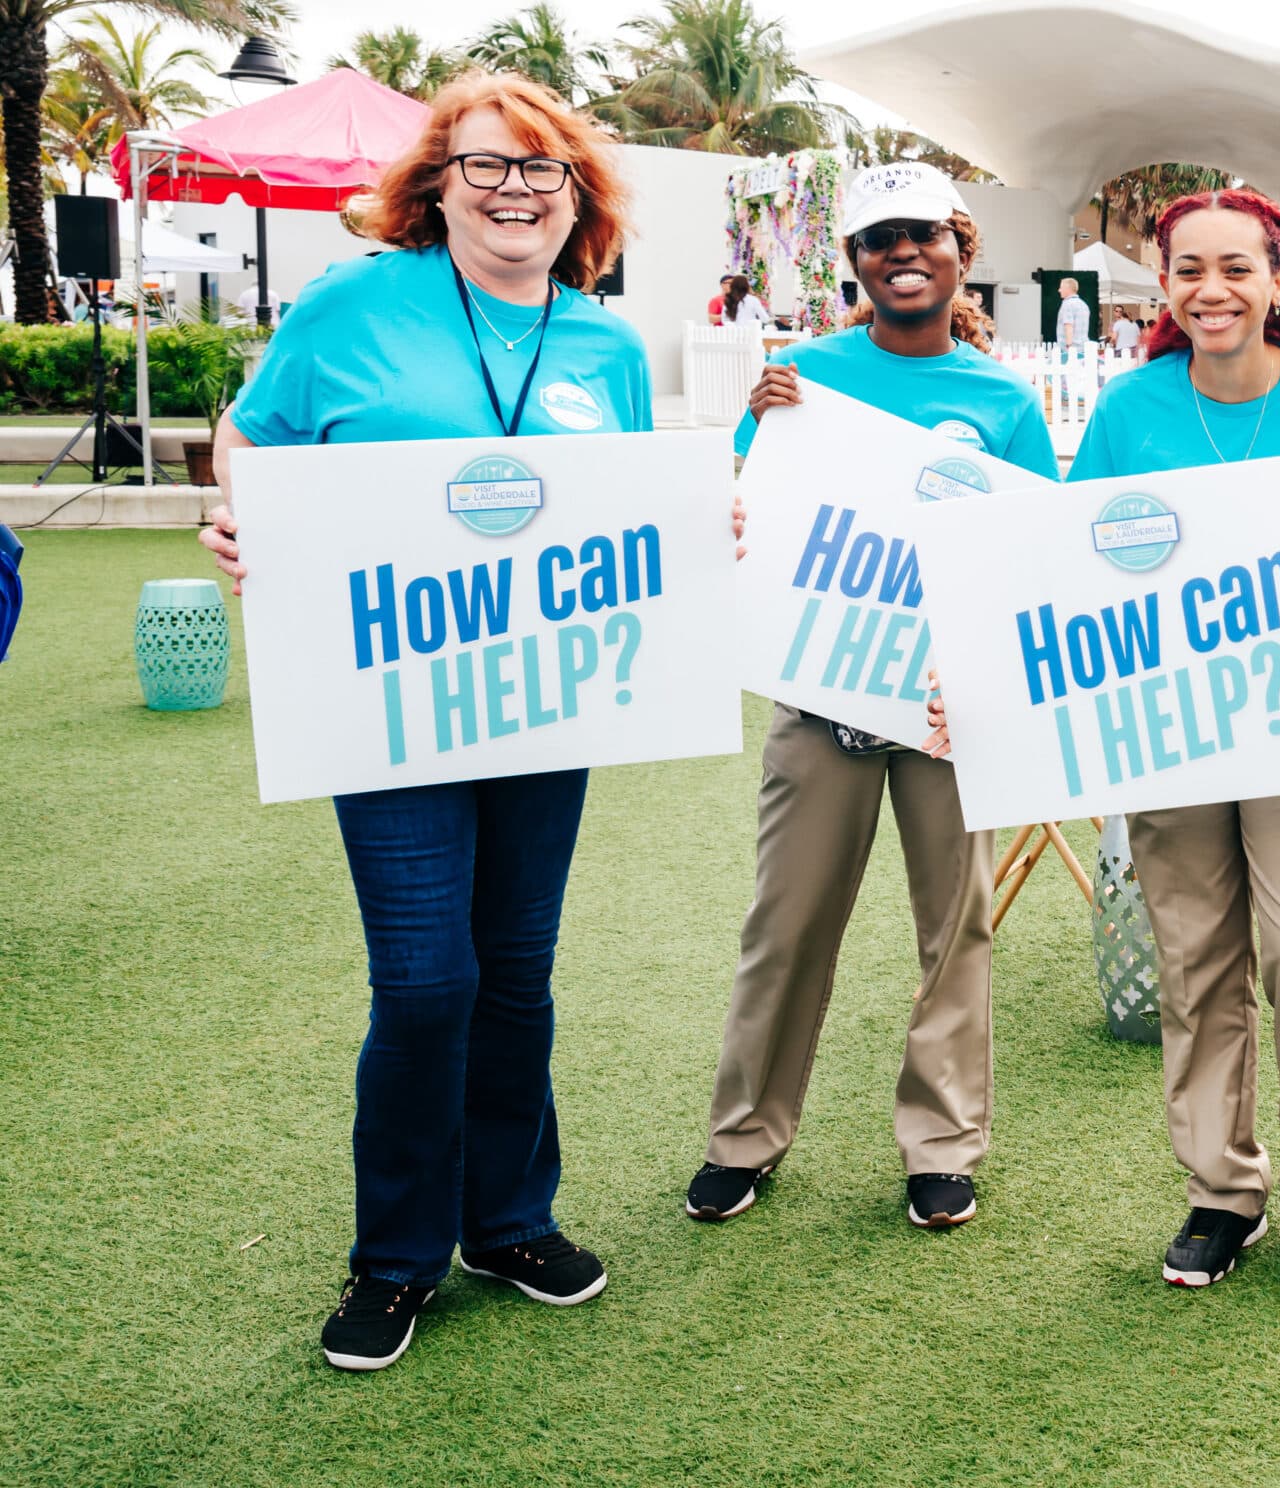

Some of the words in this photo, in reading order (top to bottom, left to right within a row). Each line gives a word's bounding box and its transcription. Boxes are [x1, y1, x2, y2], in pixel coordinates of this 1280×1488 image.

[863, 169, 921, 189] ORLANDO
[473, 483, 497, 492] VISIT
[473, 489, 537, 502] LAUDERDALE
[1115, 521, 1137, 531] VISIT
[1115, 523, 1174, 539] LAUDERDALE
[347, 556, 513, 672] How
[536, 523, 663, 623] can
[791, 503, 924, 609] How
[383, 669, 407, 767] I
[430, 612, 642, 753] HELP?
[780, 597, 822, 682] I
[820, 604, 941, 704] HEL
[1015, 591, 1162, 706] How
[1055, 705, 1083, 797] I
